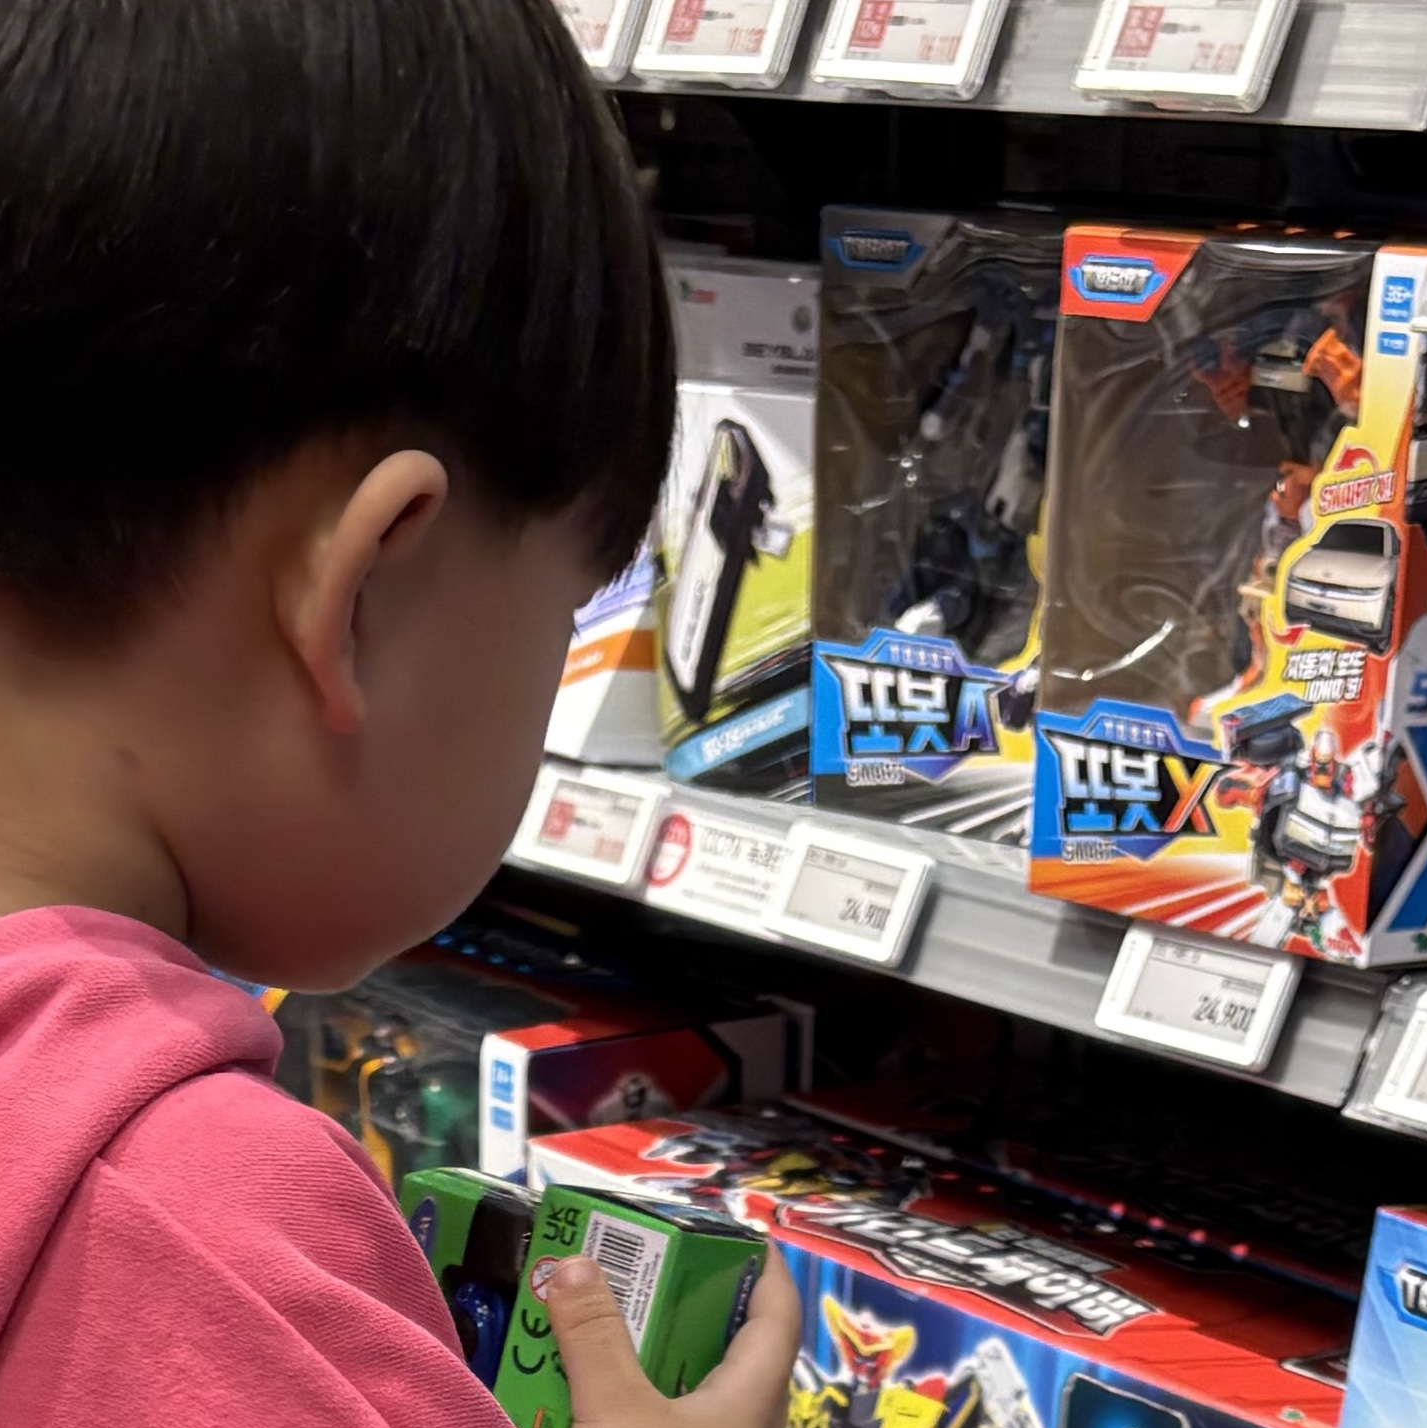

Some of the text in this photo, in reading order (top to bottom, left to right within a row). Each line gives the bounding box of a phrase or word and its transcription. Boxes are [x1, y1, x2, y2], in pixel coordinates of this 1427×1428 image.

[830, 660, 951, 753] 또봇
[952, 681, 998, 752] A
[1051, 736, 1222, 834] 또봇 X
